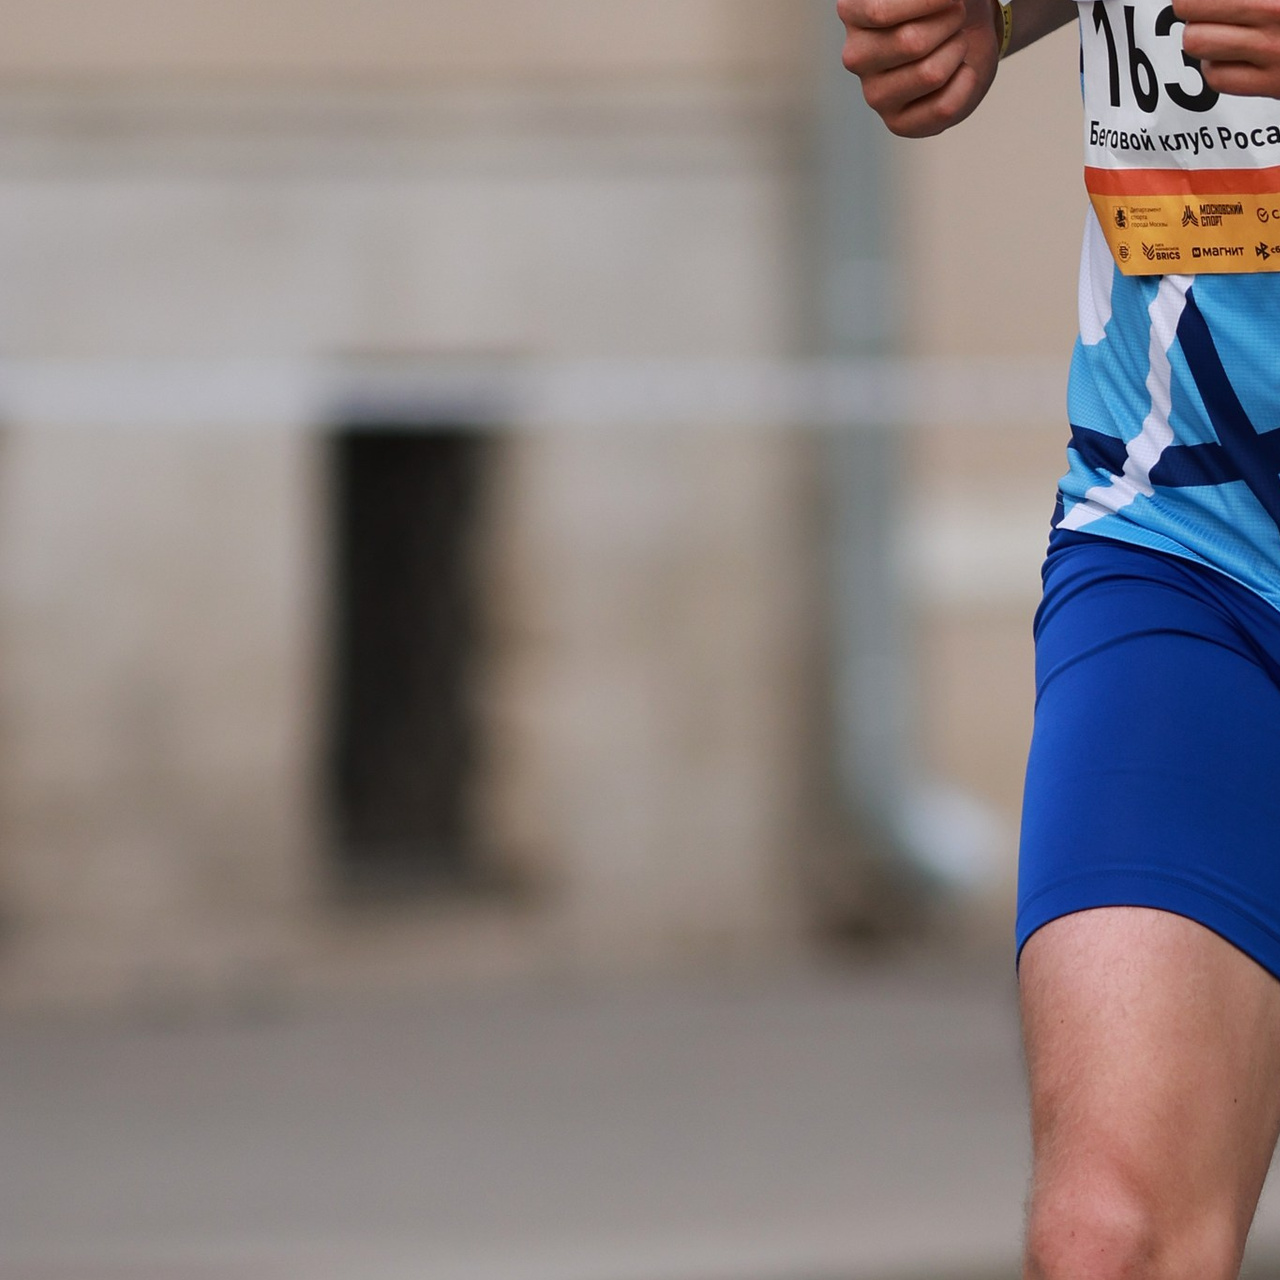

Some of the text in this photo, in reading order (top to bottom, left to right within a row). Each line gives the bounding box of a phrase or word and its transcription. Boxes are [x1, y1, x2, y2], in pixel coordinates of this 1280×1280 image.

[1092, 0, 1221, 114] 163
[1089, 120, 1156, 151] Беговой
[1158, 126, 1214, 156] клуб
[1155, 251, 1181, 261] BRICS
